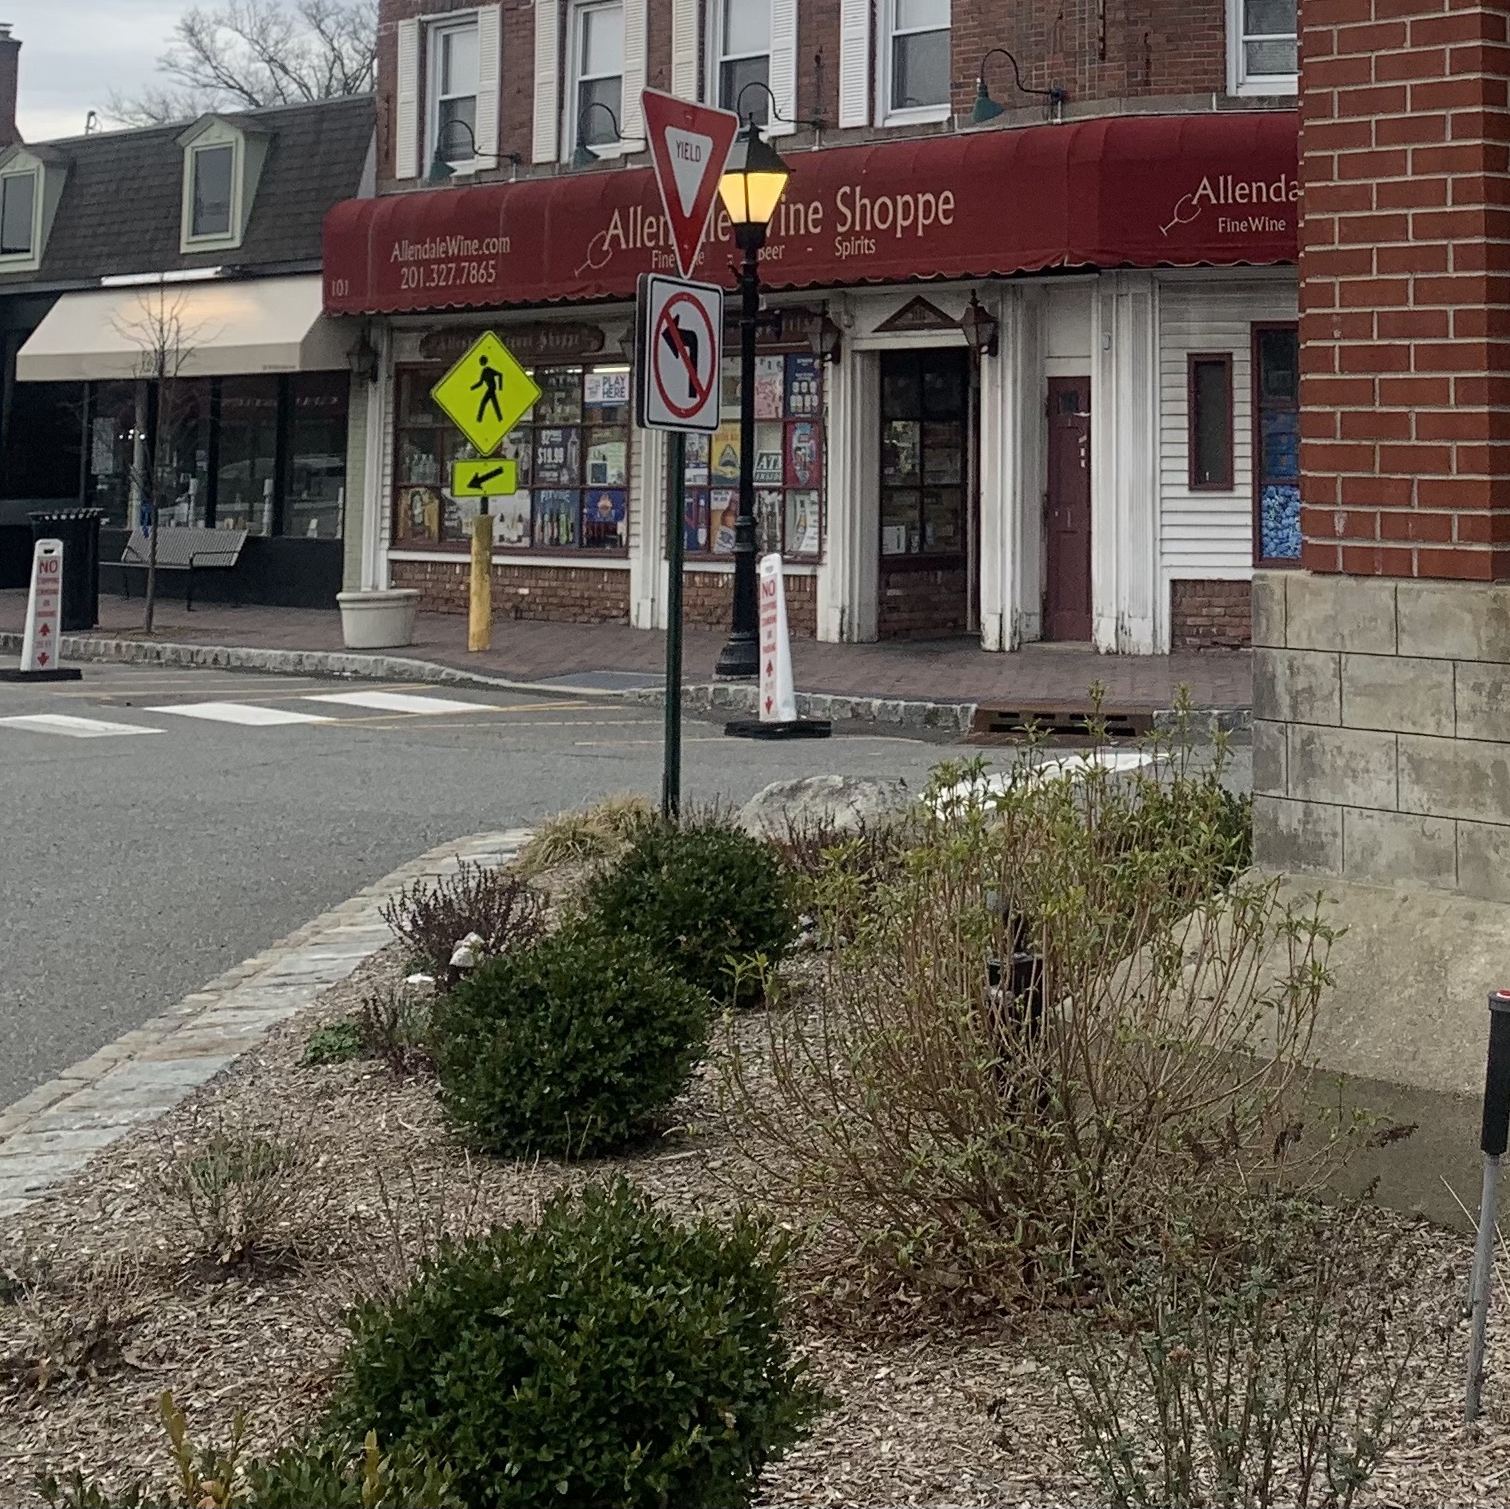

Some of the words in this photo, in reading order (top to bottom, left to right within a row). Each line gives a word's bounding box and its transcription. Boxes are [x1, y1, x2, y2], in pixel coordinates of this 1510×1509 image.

[676, 140, 702, 163] YIELD
[1191, 173, 1299, 205] Allenda
[602, 205, 733, 251] Allenle
[836, 185, 955, 238] Shoppe
[390, 235, 511, 263] AllendaleWine.com
[834, 235, 876, 260] Spirits
[400, 259, 497, 290] 201.327.7865
[331, 278, 350, 297] 101
[602, 375, 626, 387] PLAY
[602, 386, 627, 399] HERE
[39, 559, 59, 574] NO
[761, 579, 777, 599] NO
